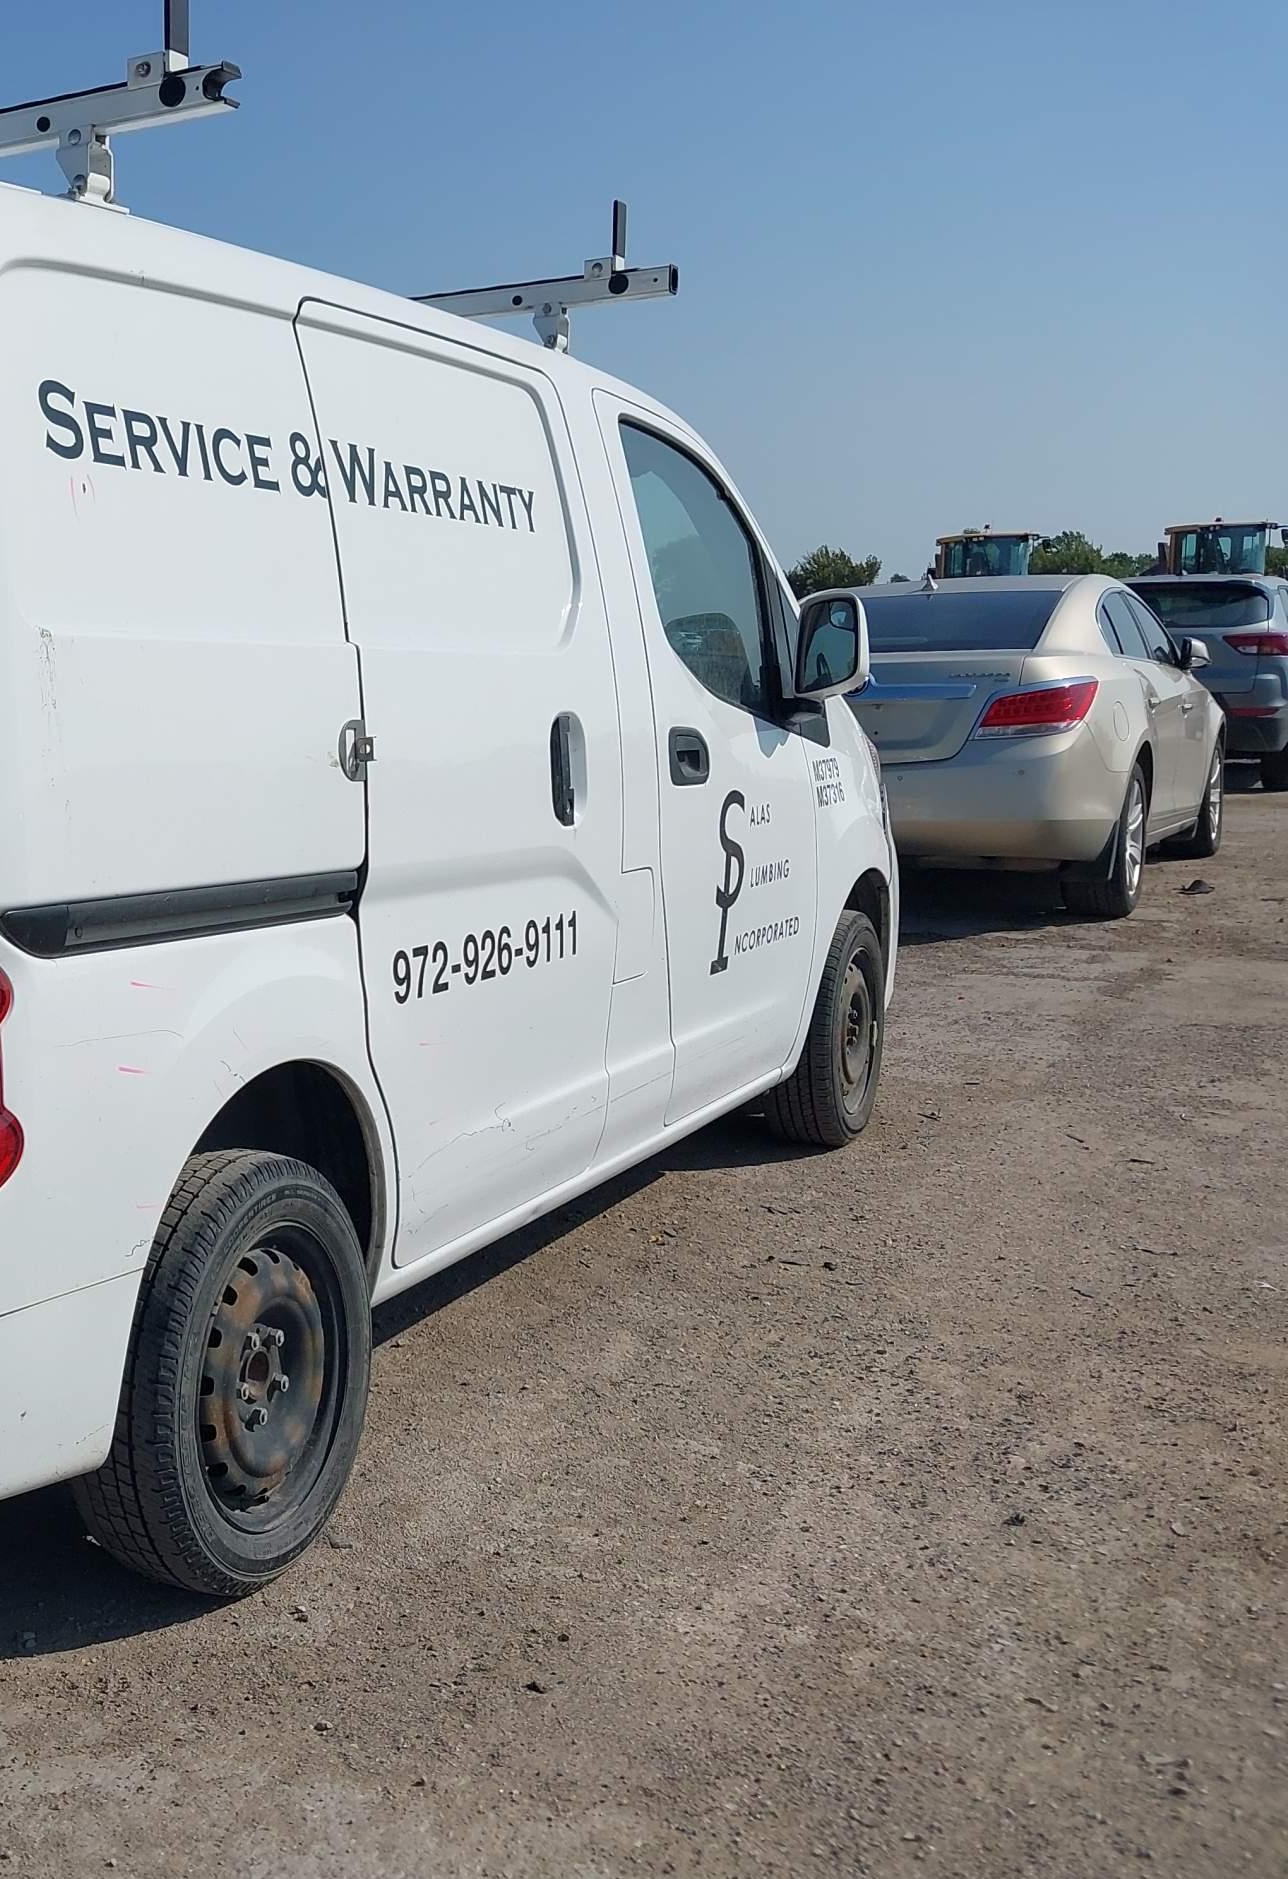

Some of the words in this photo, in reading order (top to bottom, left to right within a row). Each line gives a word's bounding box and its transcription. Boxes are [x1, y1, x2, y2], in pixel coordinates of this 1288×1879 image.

[38, 379, 281, 494] SERVICE
[290, 431, 329, 499] &
[328, 439, 536, 533] WARRANTY
[811, 757, 840, 783] M37979
[816, 781, 846, 809] M37316
[392, 910, 579, 1004] 972-926-9111
